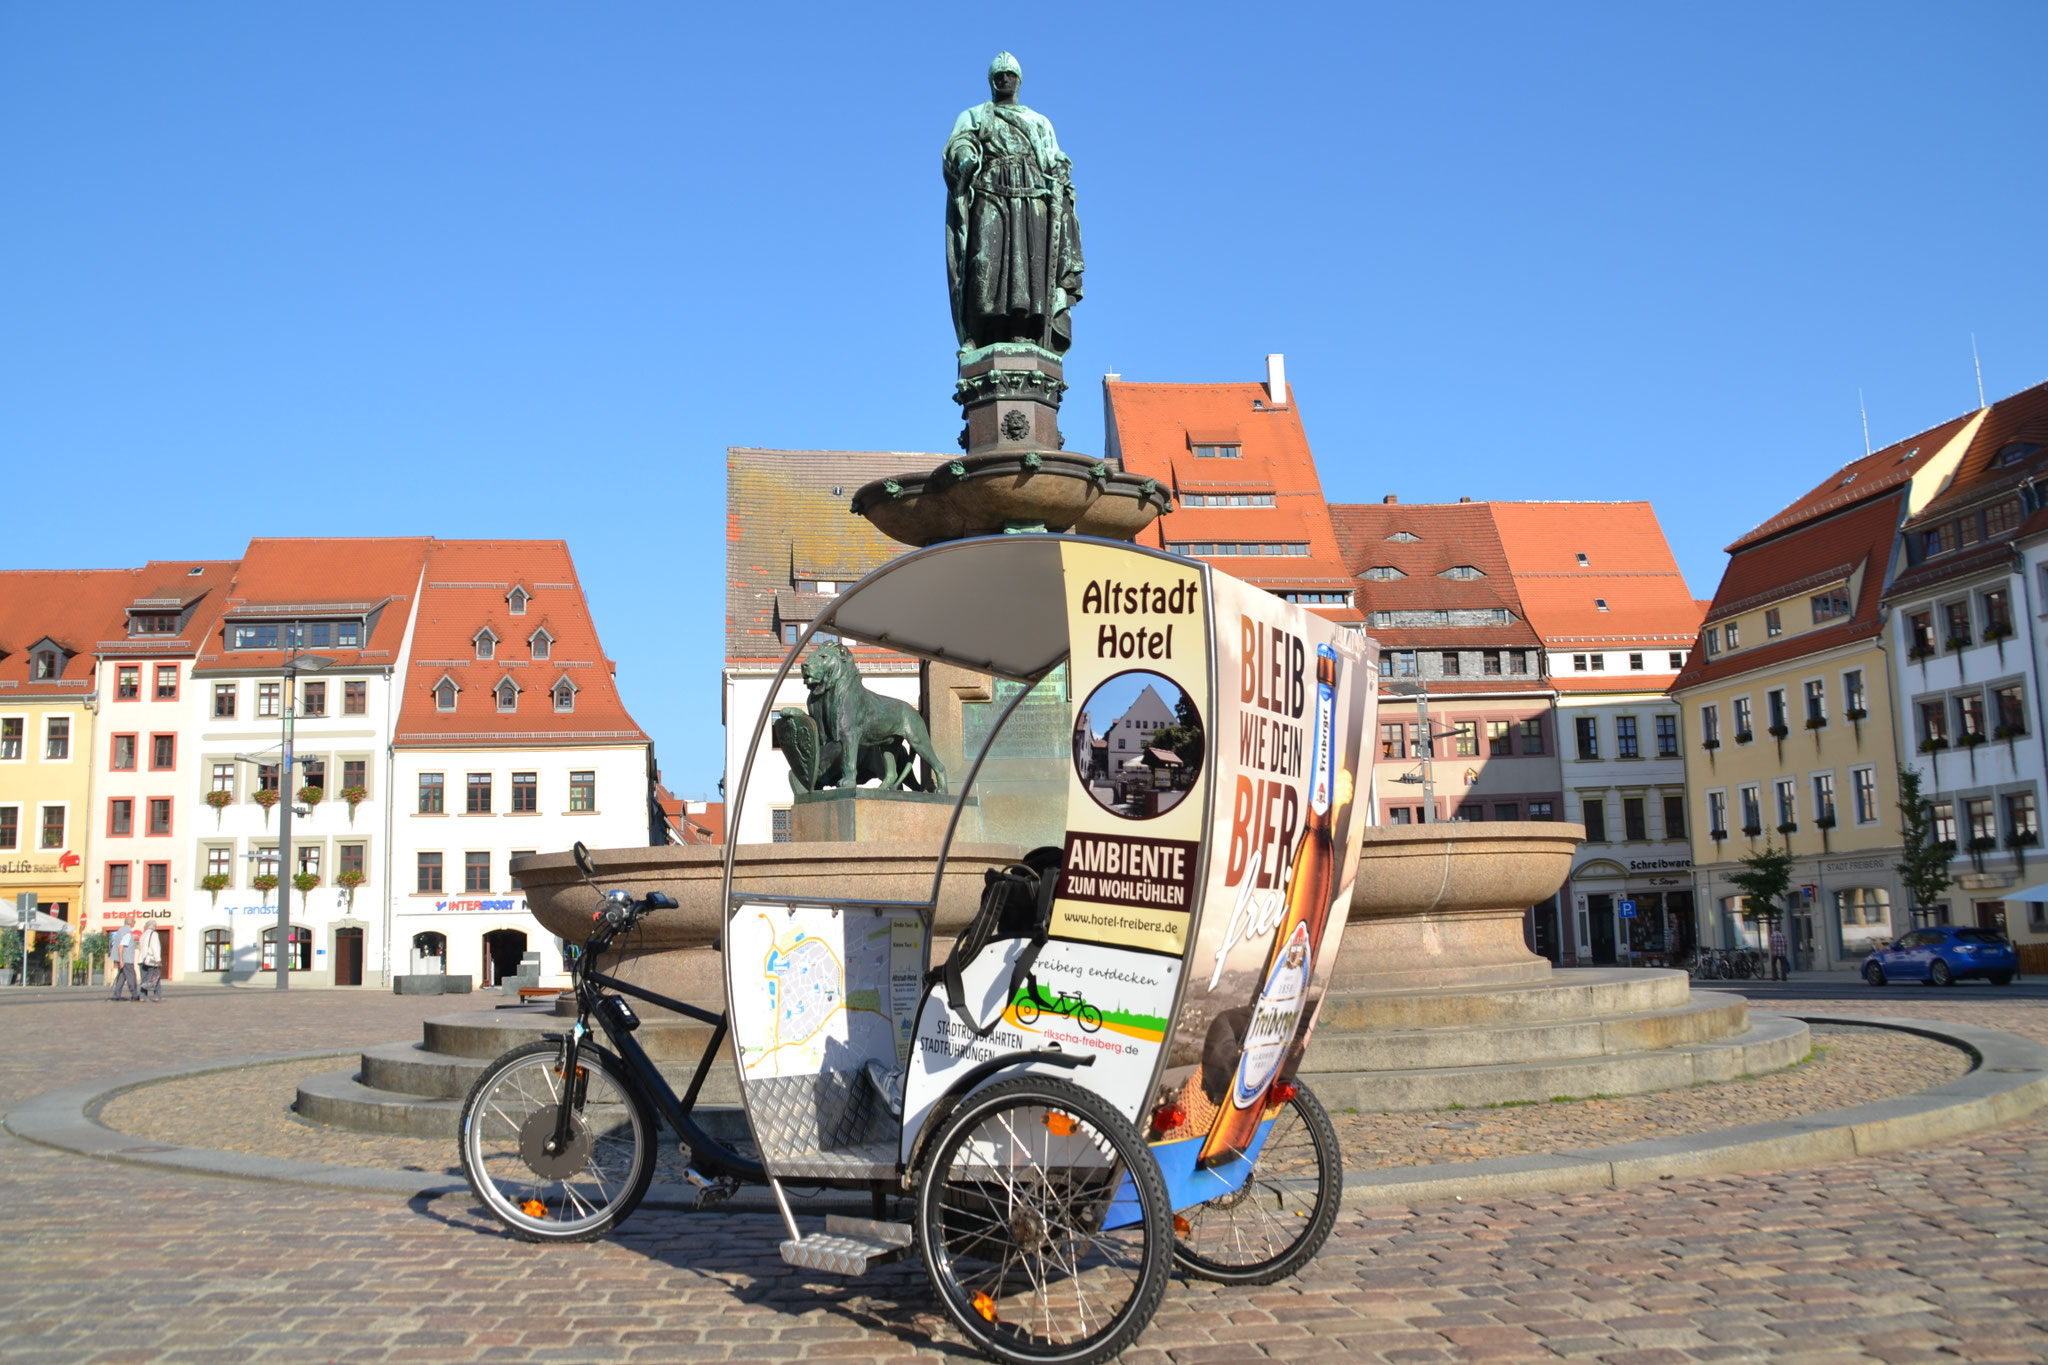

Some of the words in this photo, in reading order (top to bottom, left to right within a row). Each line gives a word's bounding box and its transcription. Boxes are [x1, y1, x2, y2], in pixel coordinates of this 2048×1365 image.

[1082, 579, 1198, 615] Altstadt
[1097, 624, 1173, 659] Hotel
[1240, 614, 1305, 719] BLEIB
[1240, 710, 1265, 770] WIE
[1270, 720, 1303, 778] DEIN
[1224, 774, 1298, 890] BIER
[1068, 839, 1185, 880] AMBIENTE
[1630, 859, 1691, 870] Schreibware
[1067, 876, 1096, 896] ZUM
[1099, 879, 1184, 905] WOHLFÜHLEN
[103, 909, 171, 919] stadtclub
[243, 904, 280, 914] randsta
[448, 900, 515, 911] INTERSPORT
[1623, 903, 1632, 916] P
[1064, 912, 1178, 934] www.hotel-freiberg.de
[1208, 849, 1292, 993] frei
[1035, 958, 1082, 978] reiberg
[1088, 967, 1159, 986] entdecken
[1044, 1029, 1139, 1055] rikscha-freiberg.de
